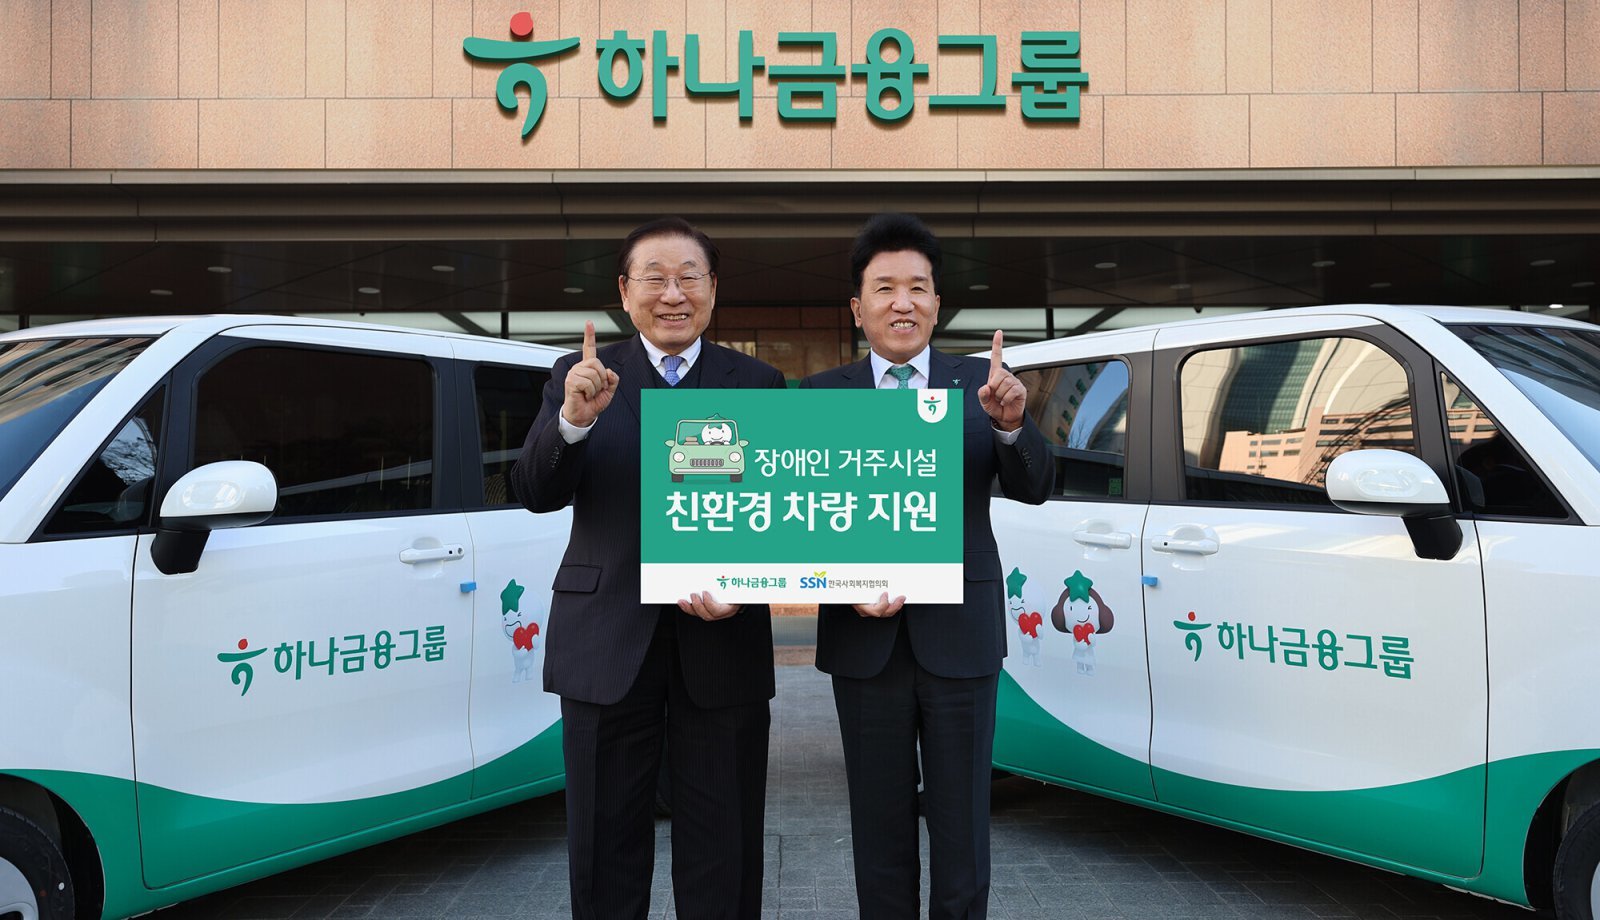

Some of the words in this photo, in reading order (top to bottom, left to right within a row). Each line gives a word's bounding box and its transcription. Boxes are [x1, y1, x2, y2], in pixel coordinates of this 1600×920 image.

[596, 28, 1089, 122] 하나금융그룹
[754, 449, 830, 477] 장애인
[838, 449, 937, 477] 거주시설
[665, 491, 771, 532] 친환경
[782, 491, 858, 532] 차량
[867, 491, 937, 532] 지원
[731, 577, 787, 588] 하나금융그룹
[799, 577, 827, 589] SSN
[828, 579, 889, 588] 한국사회복지협의회
[273, 625, 447, 680] 하나금융그룹
[1217, 622, 1414, 680] 하나금융그룹
